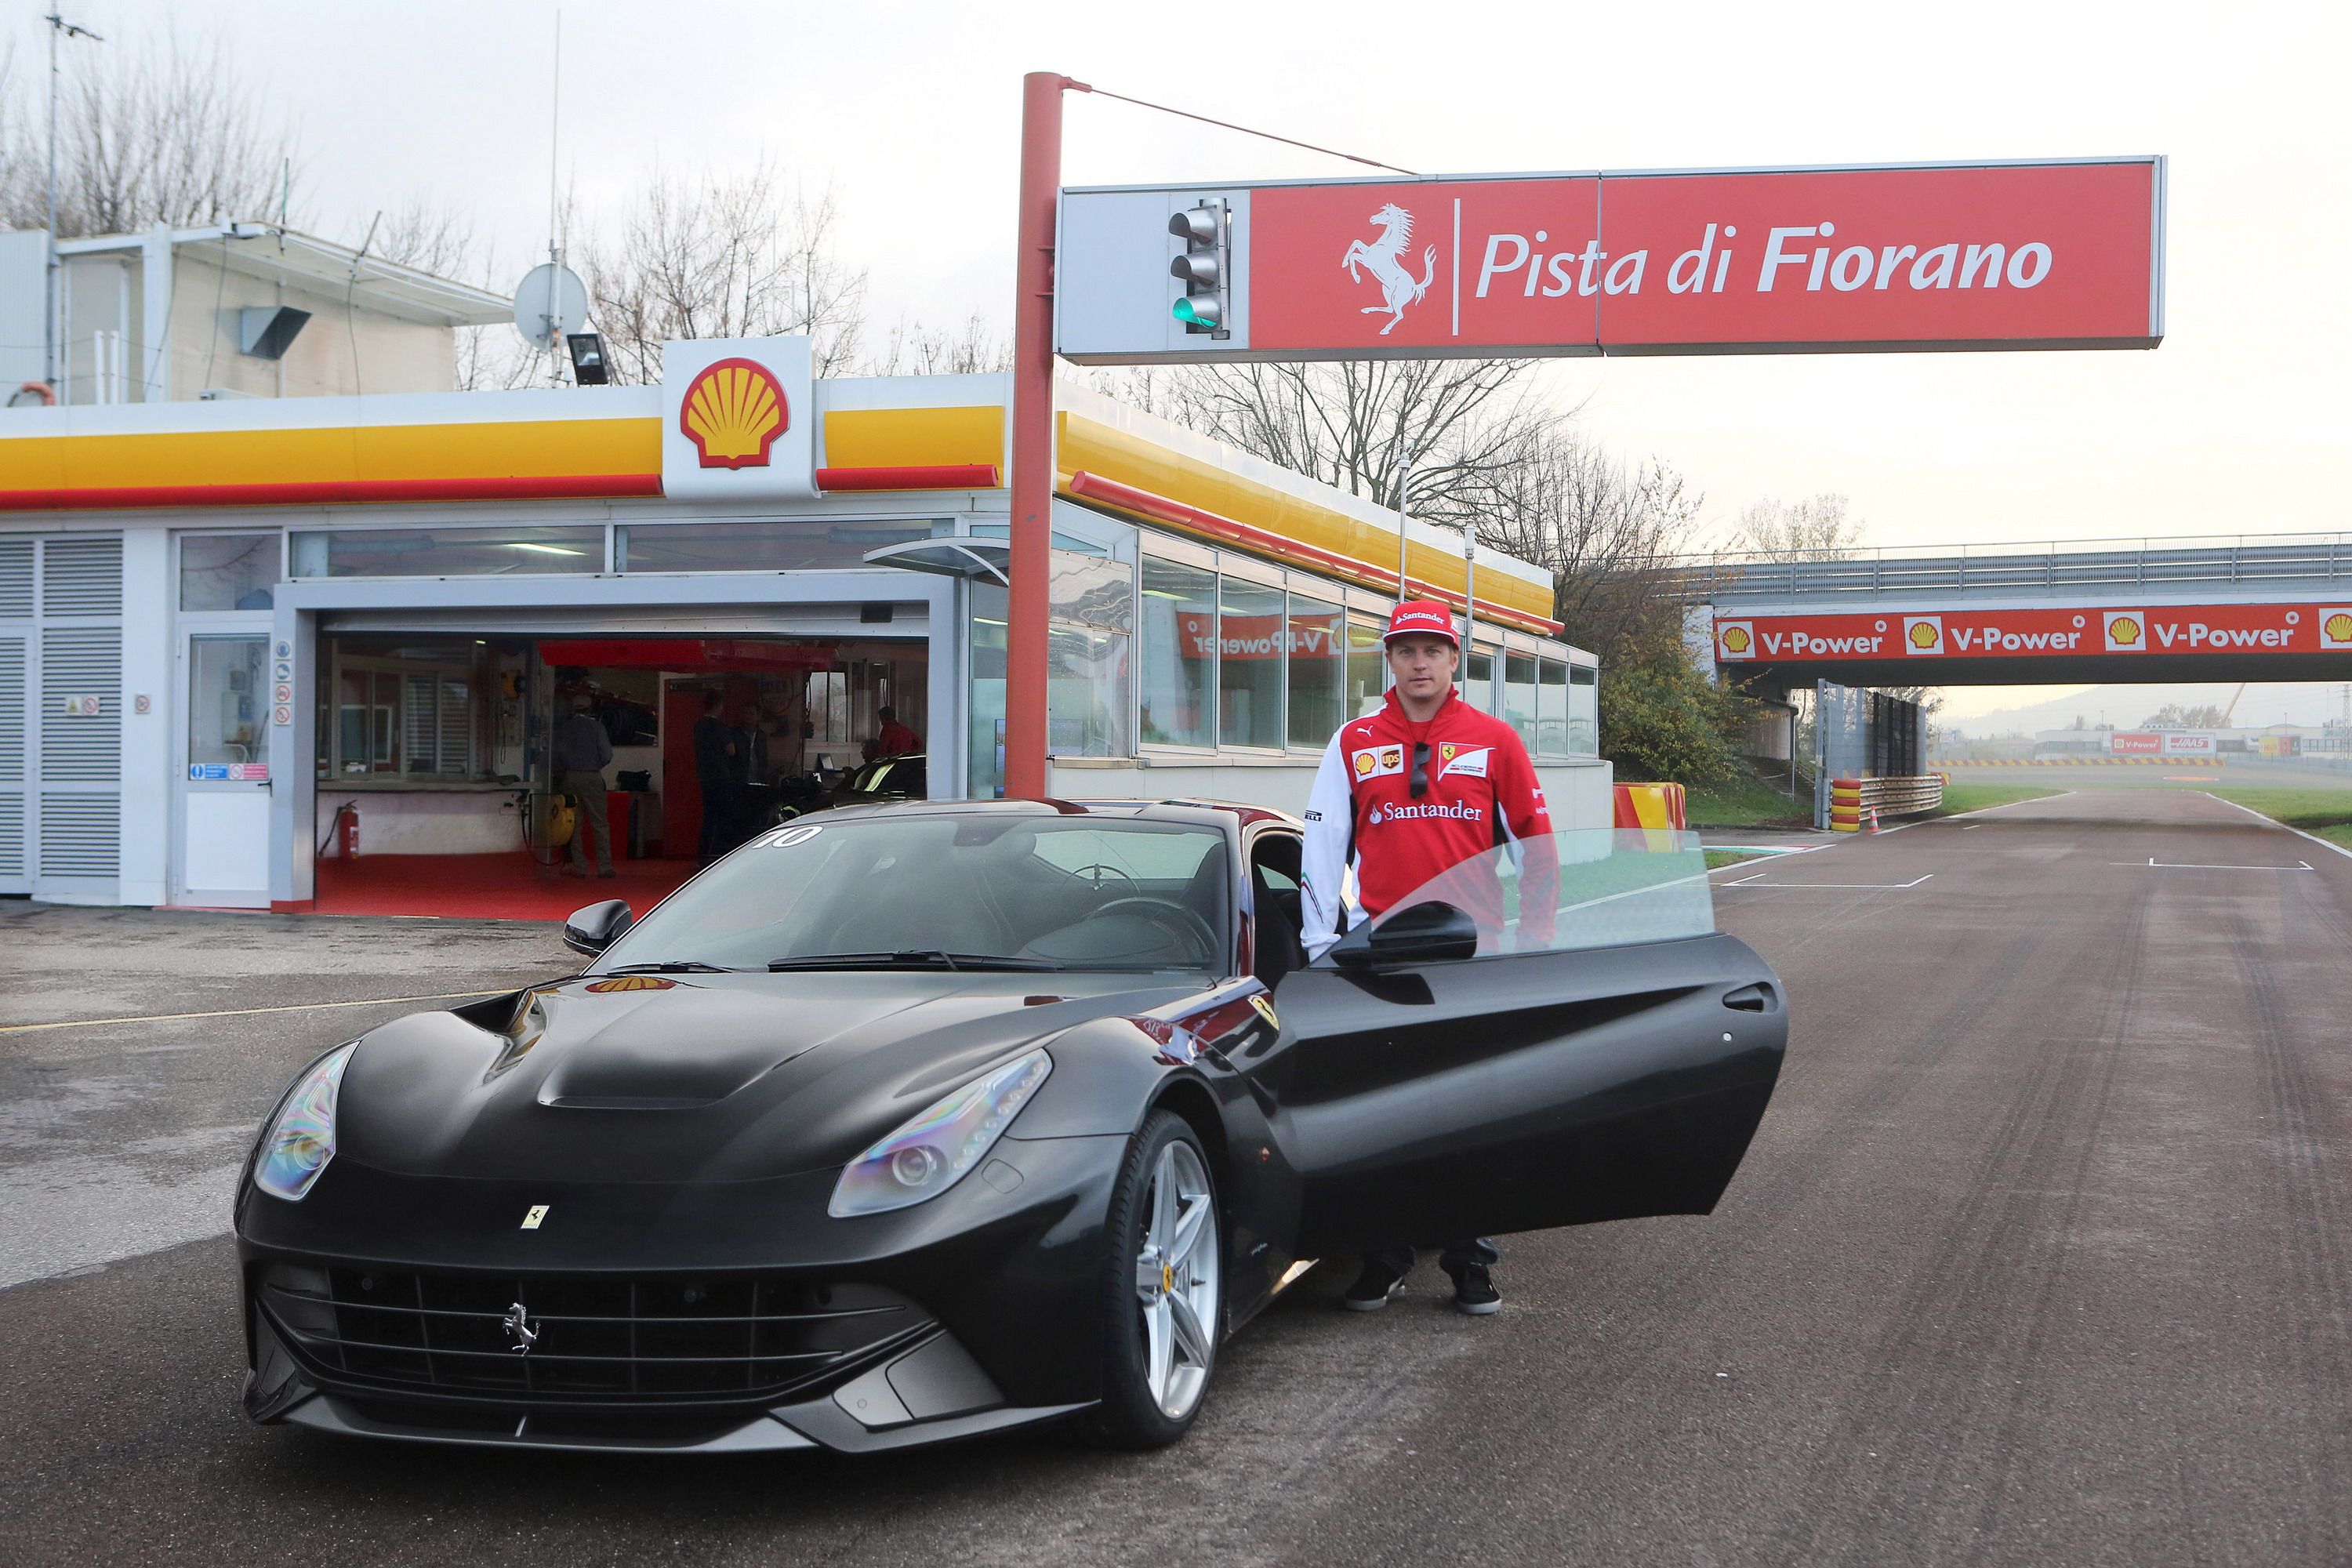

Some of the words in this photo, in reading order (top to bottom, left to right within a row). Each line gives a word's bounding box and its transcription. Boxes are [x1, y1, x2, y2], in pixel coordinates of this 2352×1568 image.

[1475, 230, 1649, 298] Pista
[1666, 223, 1737, 294] di
[1756, 221, 2053, 292] Fiorano
[1402, 612, 1445, 625] Santander
[1761, 631, 1883, 655] V-Power
[1951, 626, 2081, 652] V-Power
[2154, 622, 2294, 648] V-Power
[2125, 740, 2157, 749] V-Power
[1382, 753, 1399, 767] ups
[1384, 800, 1482, 822] Santander
[752, 826, 824, 849] 10
